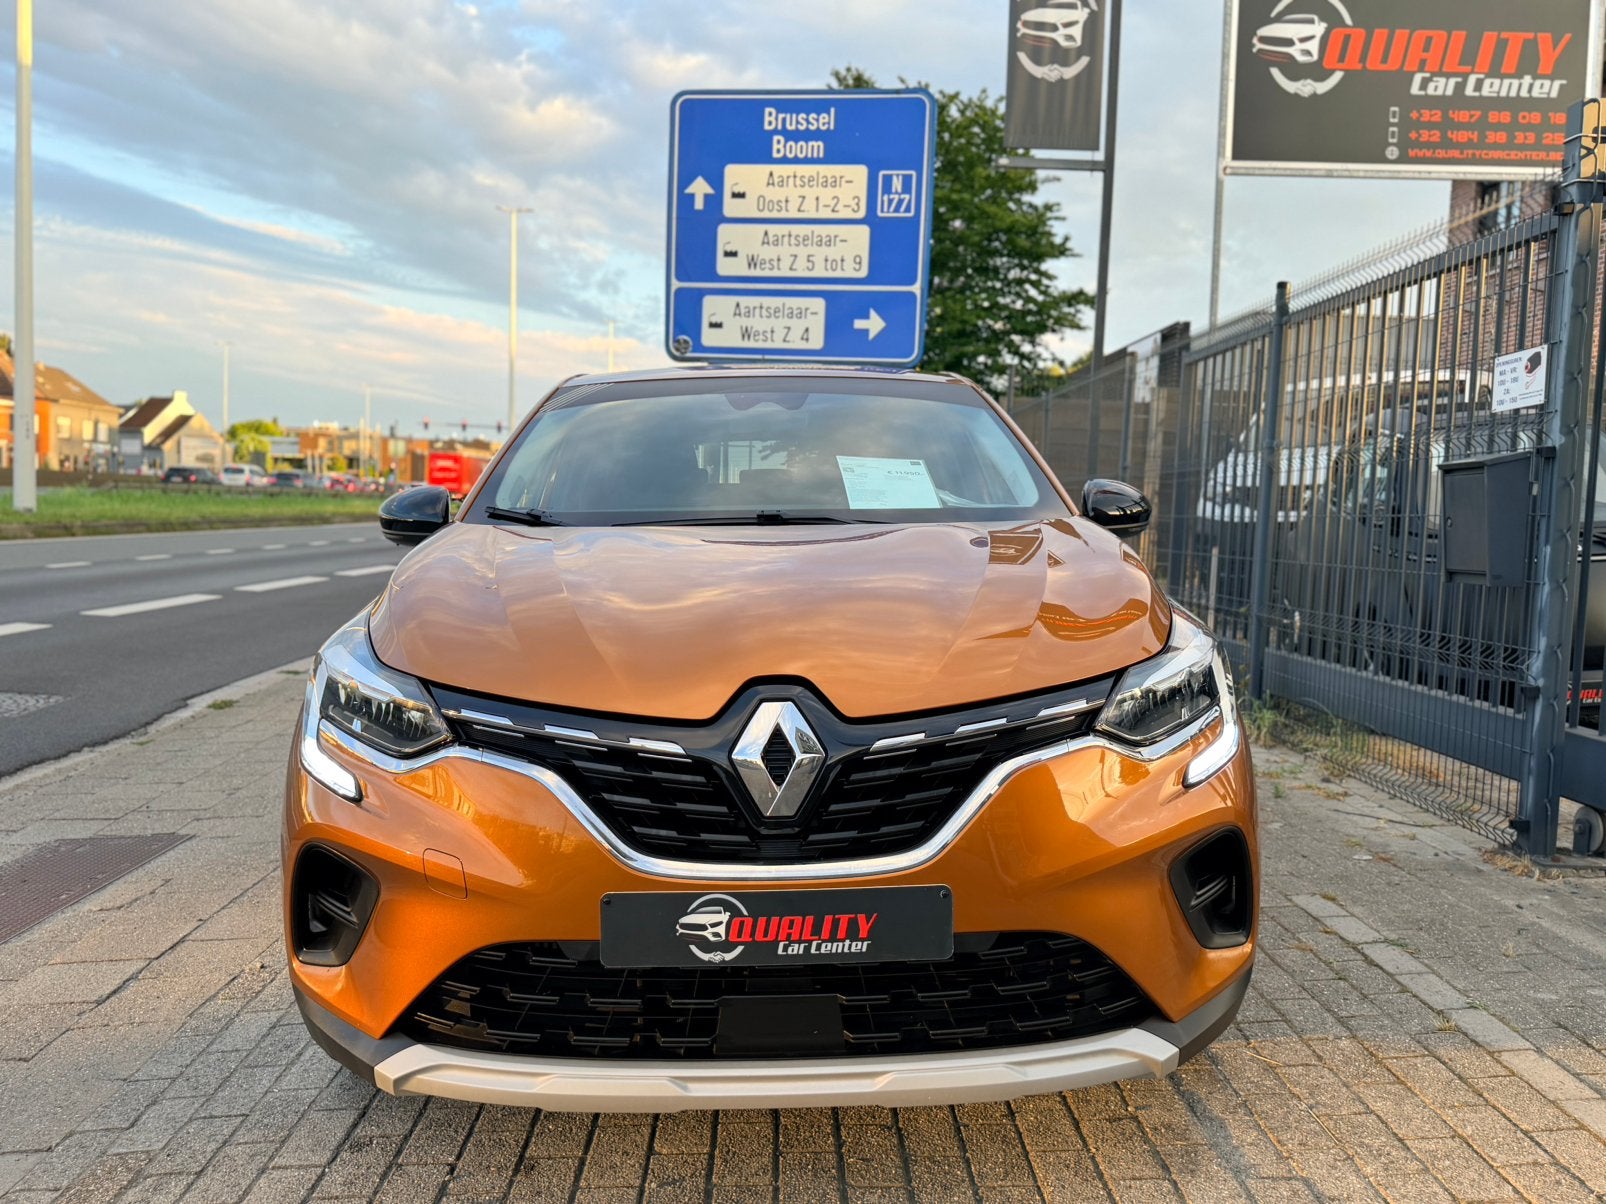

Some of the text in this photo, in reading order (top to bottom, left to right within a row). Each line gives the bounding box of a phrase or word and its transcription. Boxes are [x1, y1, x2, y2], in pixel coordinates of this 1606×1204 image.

[1322, 28, 1572, 74] QUALITY
[1410, 72, 1568, 98] Car Center
[763, 107, 835, 130] Brussel
[1409, 109, 1442, 123] +32
[1448, 109, 1482, 123] 487
[1408, 129, 1441, 143] +32
[1447, 129, 1479, 143] 484
[1513, 132, 1536, 145] 33
[772, 135, 824, 159] Boom
[766, 170, 854, 188] Aartselaar-
[891, 175, 903, 193] N
[756, 195, 790, 213] Oost
[882, 194, 911, 213] 177
[761, 229, 848, 247] Aartselaar-
[746, 254, 782, 271] West
[824, 255, 846, 272] tot
[853, 254, 863, 272] 9
[733, 301, 819, 319] Aartselaar-
[740, 325, 775, 343] West
[729, 912, 878, 942] QUALITY
[777, 939, 872, 955] Car Center
